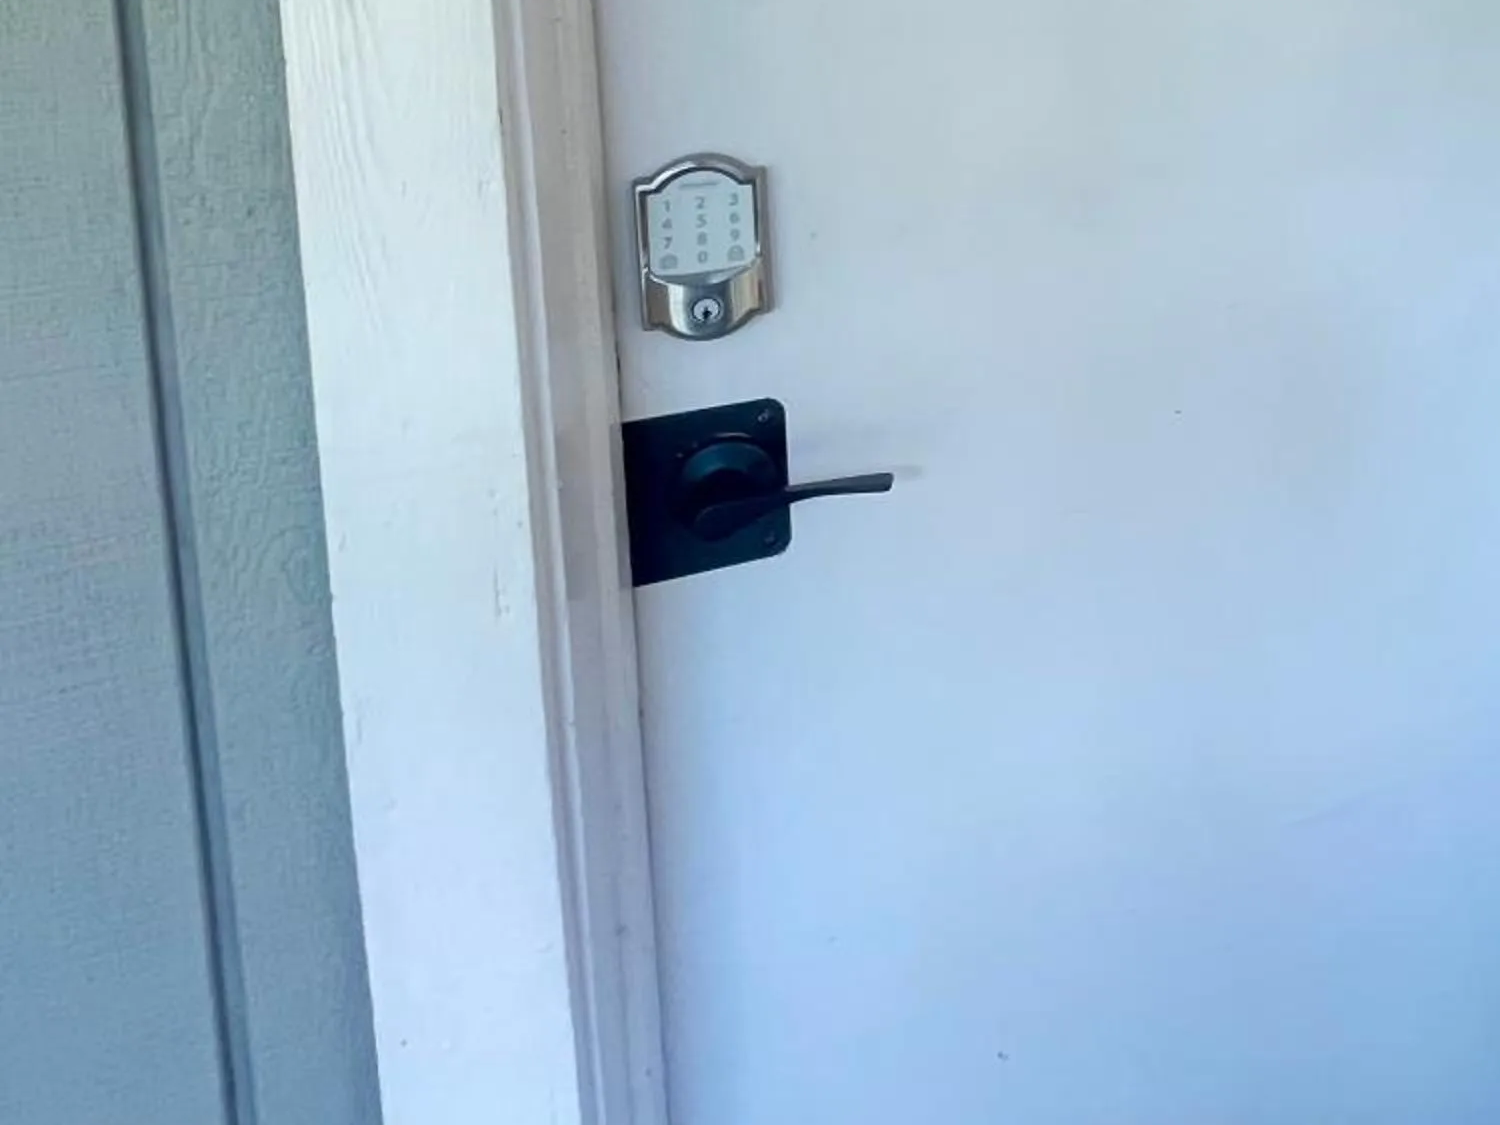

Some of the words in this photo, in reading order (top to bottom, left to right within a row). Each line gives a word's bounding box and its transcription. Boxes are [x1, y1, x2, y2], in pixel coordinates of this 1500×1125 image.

[663, 199, 671, 213] 1
[695, 196, 705, 210] 2
[728, 192, 739, 206] 3
[662, 217, 673, 229] 4
[695, 214, 707, 229] 5
[729, 212, 740, 225] 6
[662, 236, 673, 250] 7
[697, 231, 708, 246] 8
[729, 228, 740, 242] 9
[697, 250, 708, 264] 0
